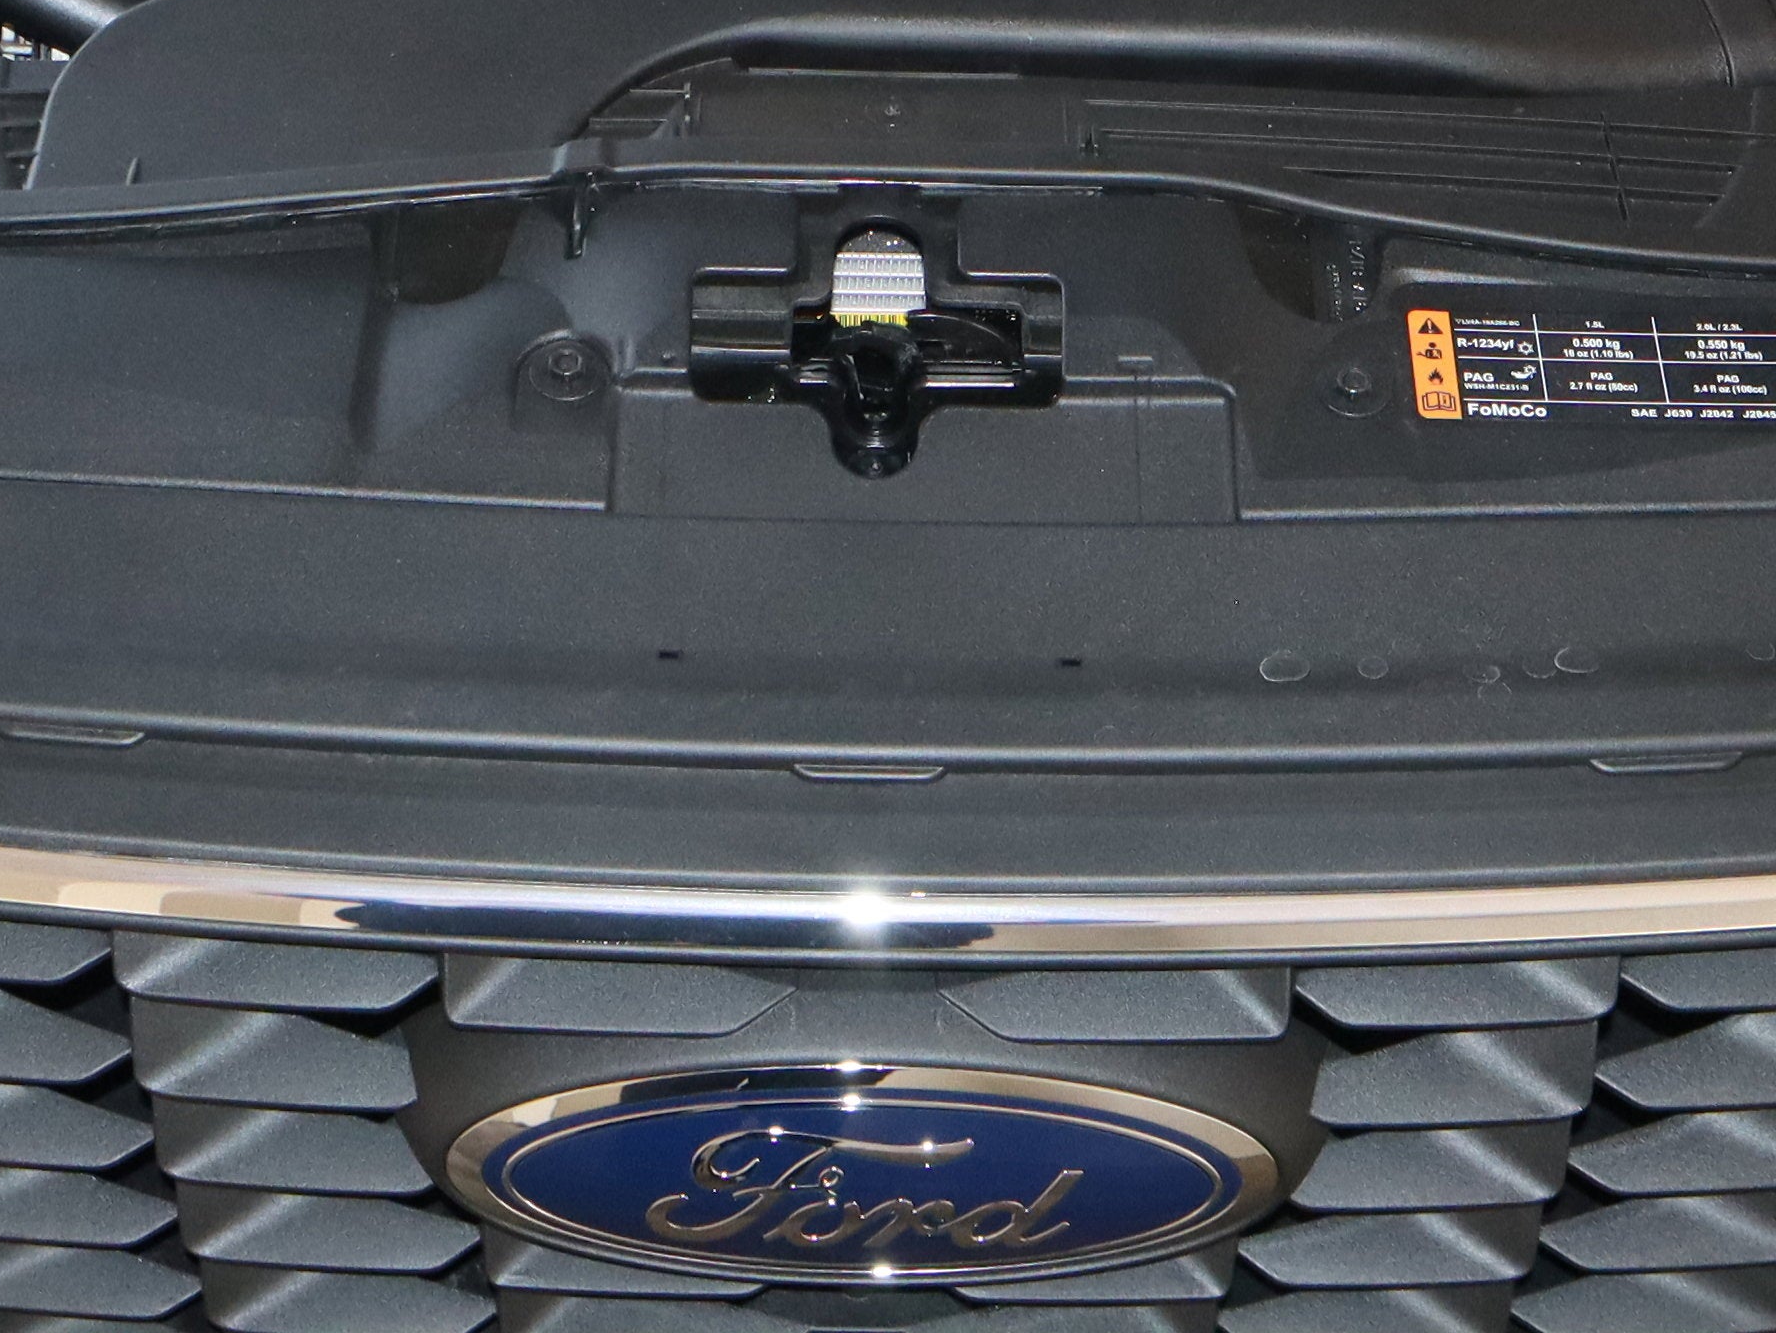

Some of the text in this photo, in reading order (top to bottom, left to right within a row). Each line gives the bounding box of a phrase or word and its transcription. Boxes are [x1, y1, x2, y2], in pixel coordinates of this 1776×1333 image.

[1585, 321, 1605, 329] 1.5L
[1456, 337, 1514, 351] R-1234yf
[1572, 338, 1620, 350] 0.500 kg
[1697, 340, 1746, 351] 0.550 kg
[1590, 349, 1614, 359] (1.10
[1615, 350, 1634, 359] lbs)
[1706, 352, 1719, 360] oz
[1744, 351, 1763, 361] lbs)
[1463, 372, 1494, 382] PAG
[1590, 372, 1613, 381] PAG
[1716, 374, 1740, 383] PAG
[1569, 382, 1583, 391] 2.7
[1586, 382, 1594, 391] fl
[1693, 385, 1708, 393] 3.4
[1710, 385, 1717, 393] fl
[1467, 403, 1547, 418] FoMoCo
[1631, 408, 1658, 418] SAE
[645, 1129, 1084, 1248] Ford
